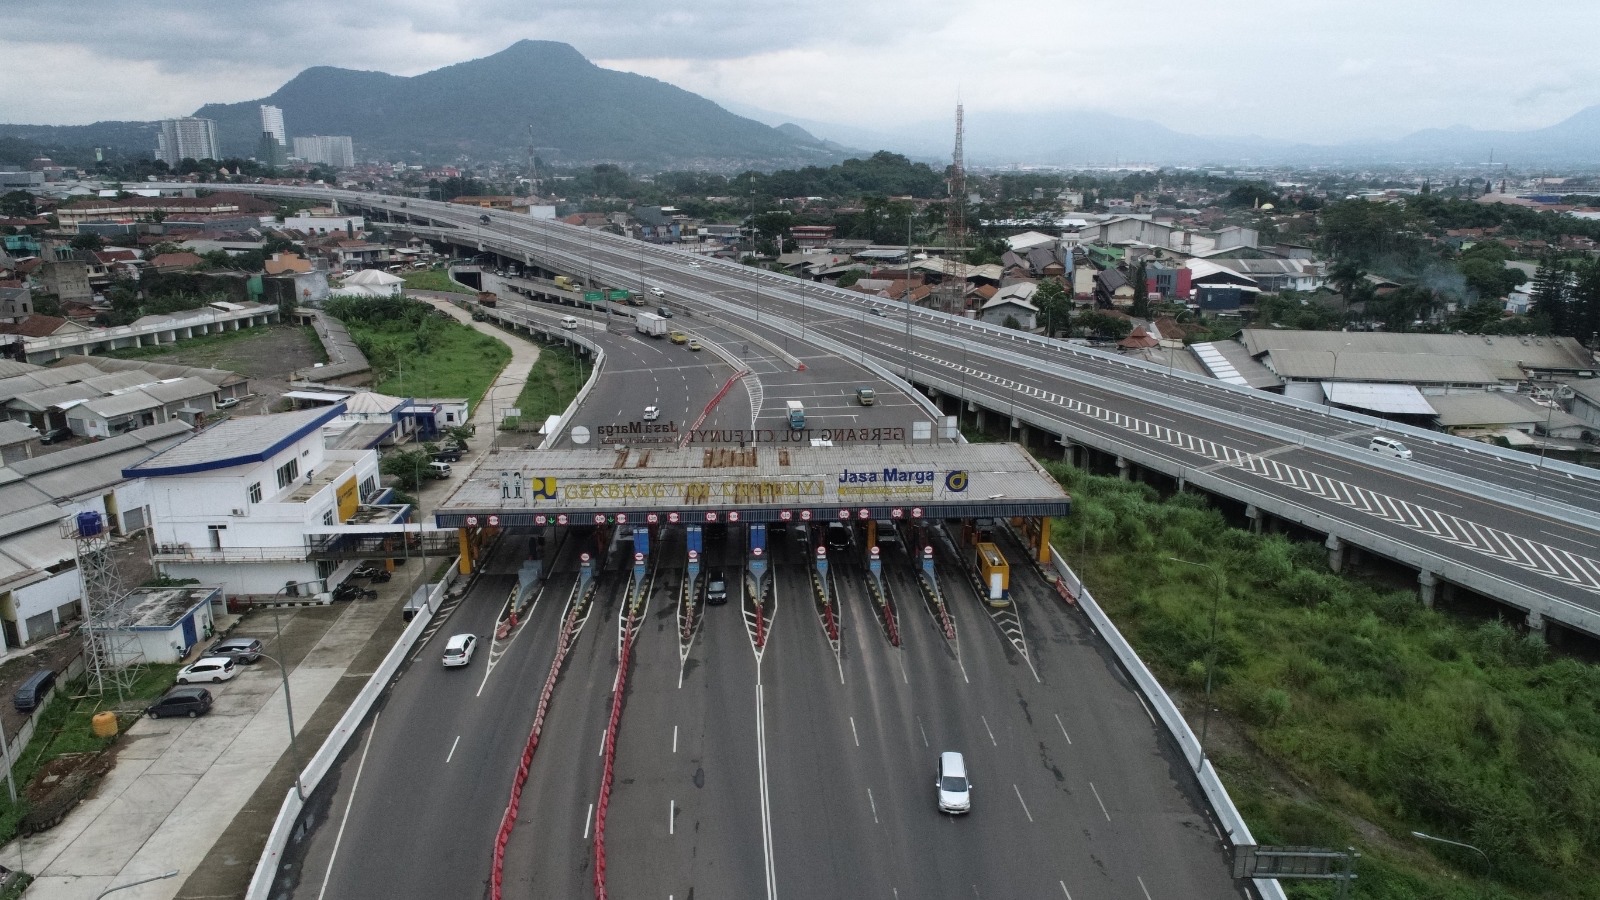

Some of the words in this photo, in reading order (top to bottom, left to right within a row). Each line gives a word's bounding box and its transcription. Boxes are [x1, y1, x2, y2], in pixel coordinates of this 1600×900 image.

[839, 468, 878, 483] Jasa
[883, 468, 934, 484] Marga
[564, 482, 665, 499] GERBANG
